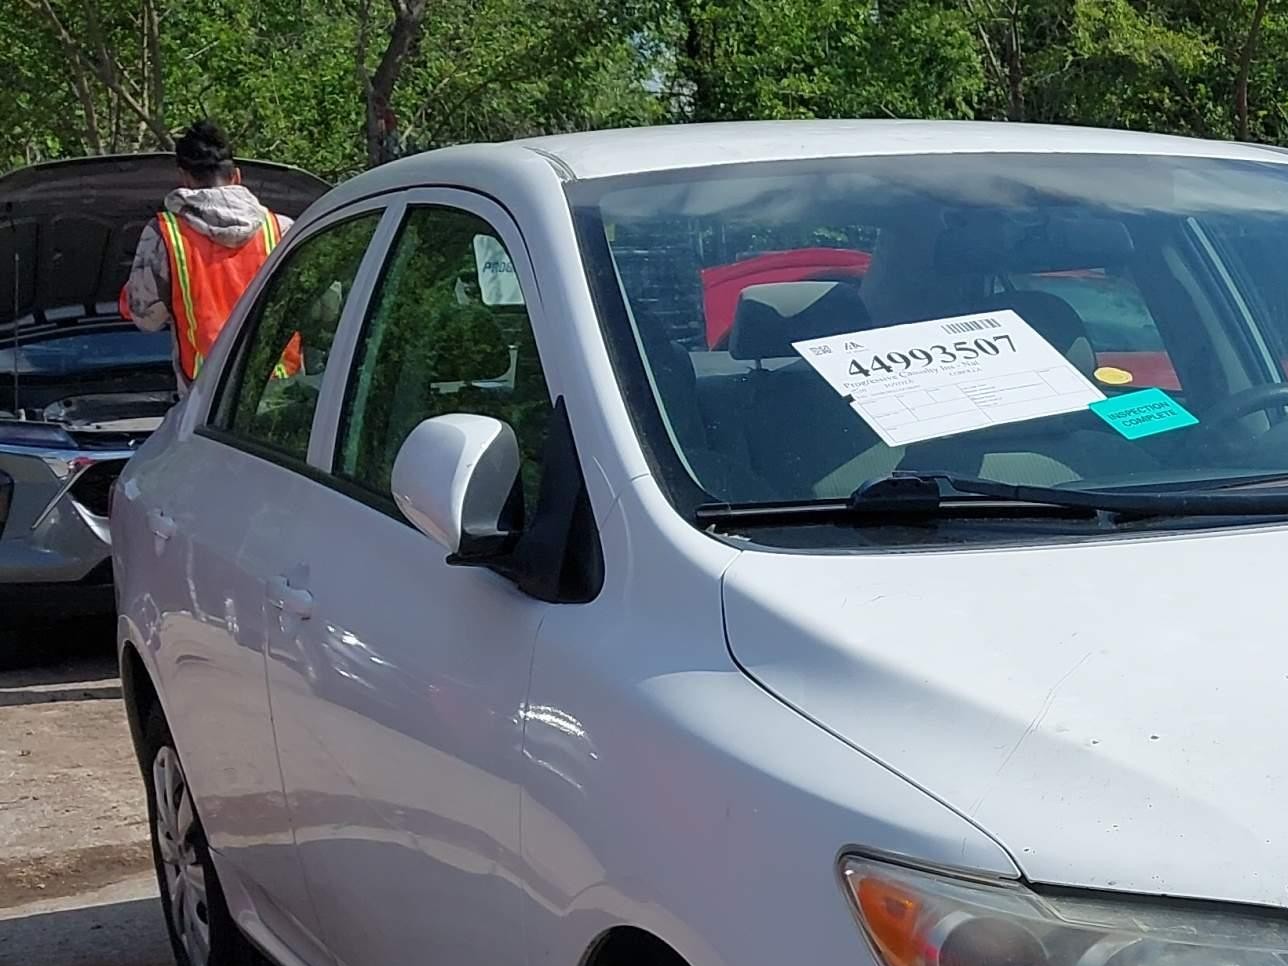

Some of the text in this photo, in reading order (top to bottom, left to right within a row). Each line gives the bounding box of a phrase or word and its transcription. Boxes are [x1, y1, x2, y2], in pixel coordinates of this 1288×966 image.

[849, 334, 1016, 377] 44993507
[1107, 401, 1170, 421] INSPECTION
[1122, 409, 1177, 427] COMPLETE
